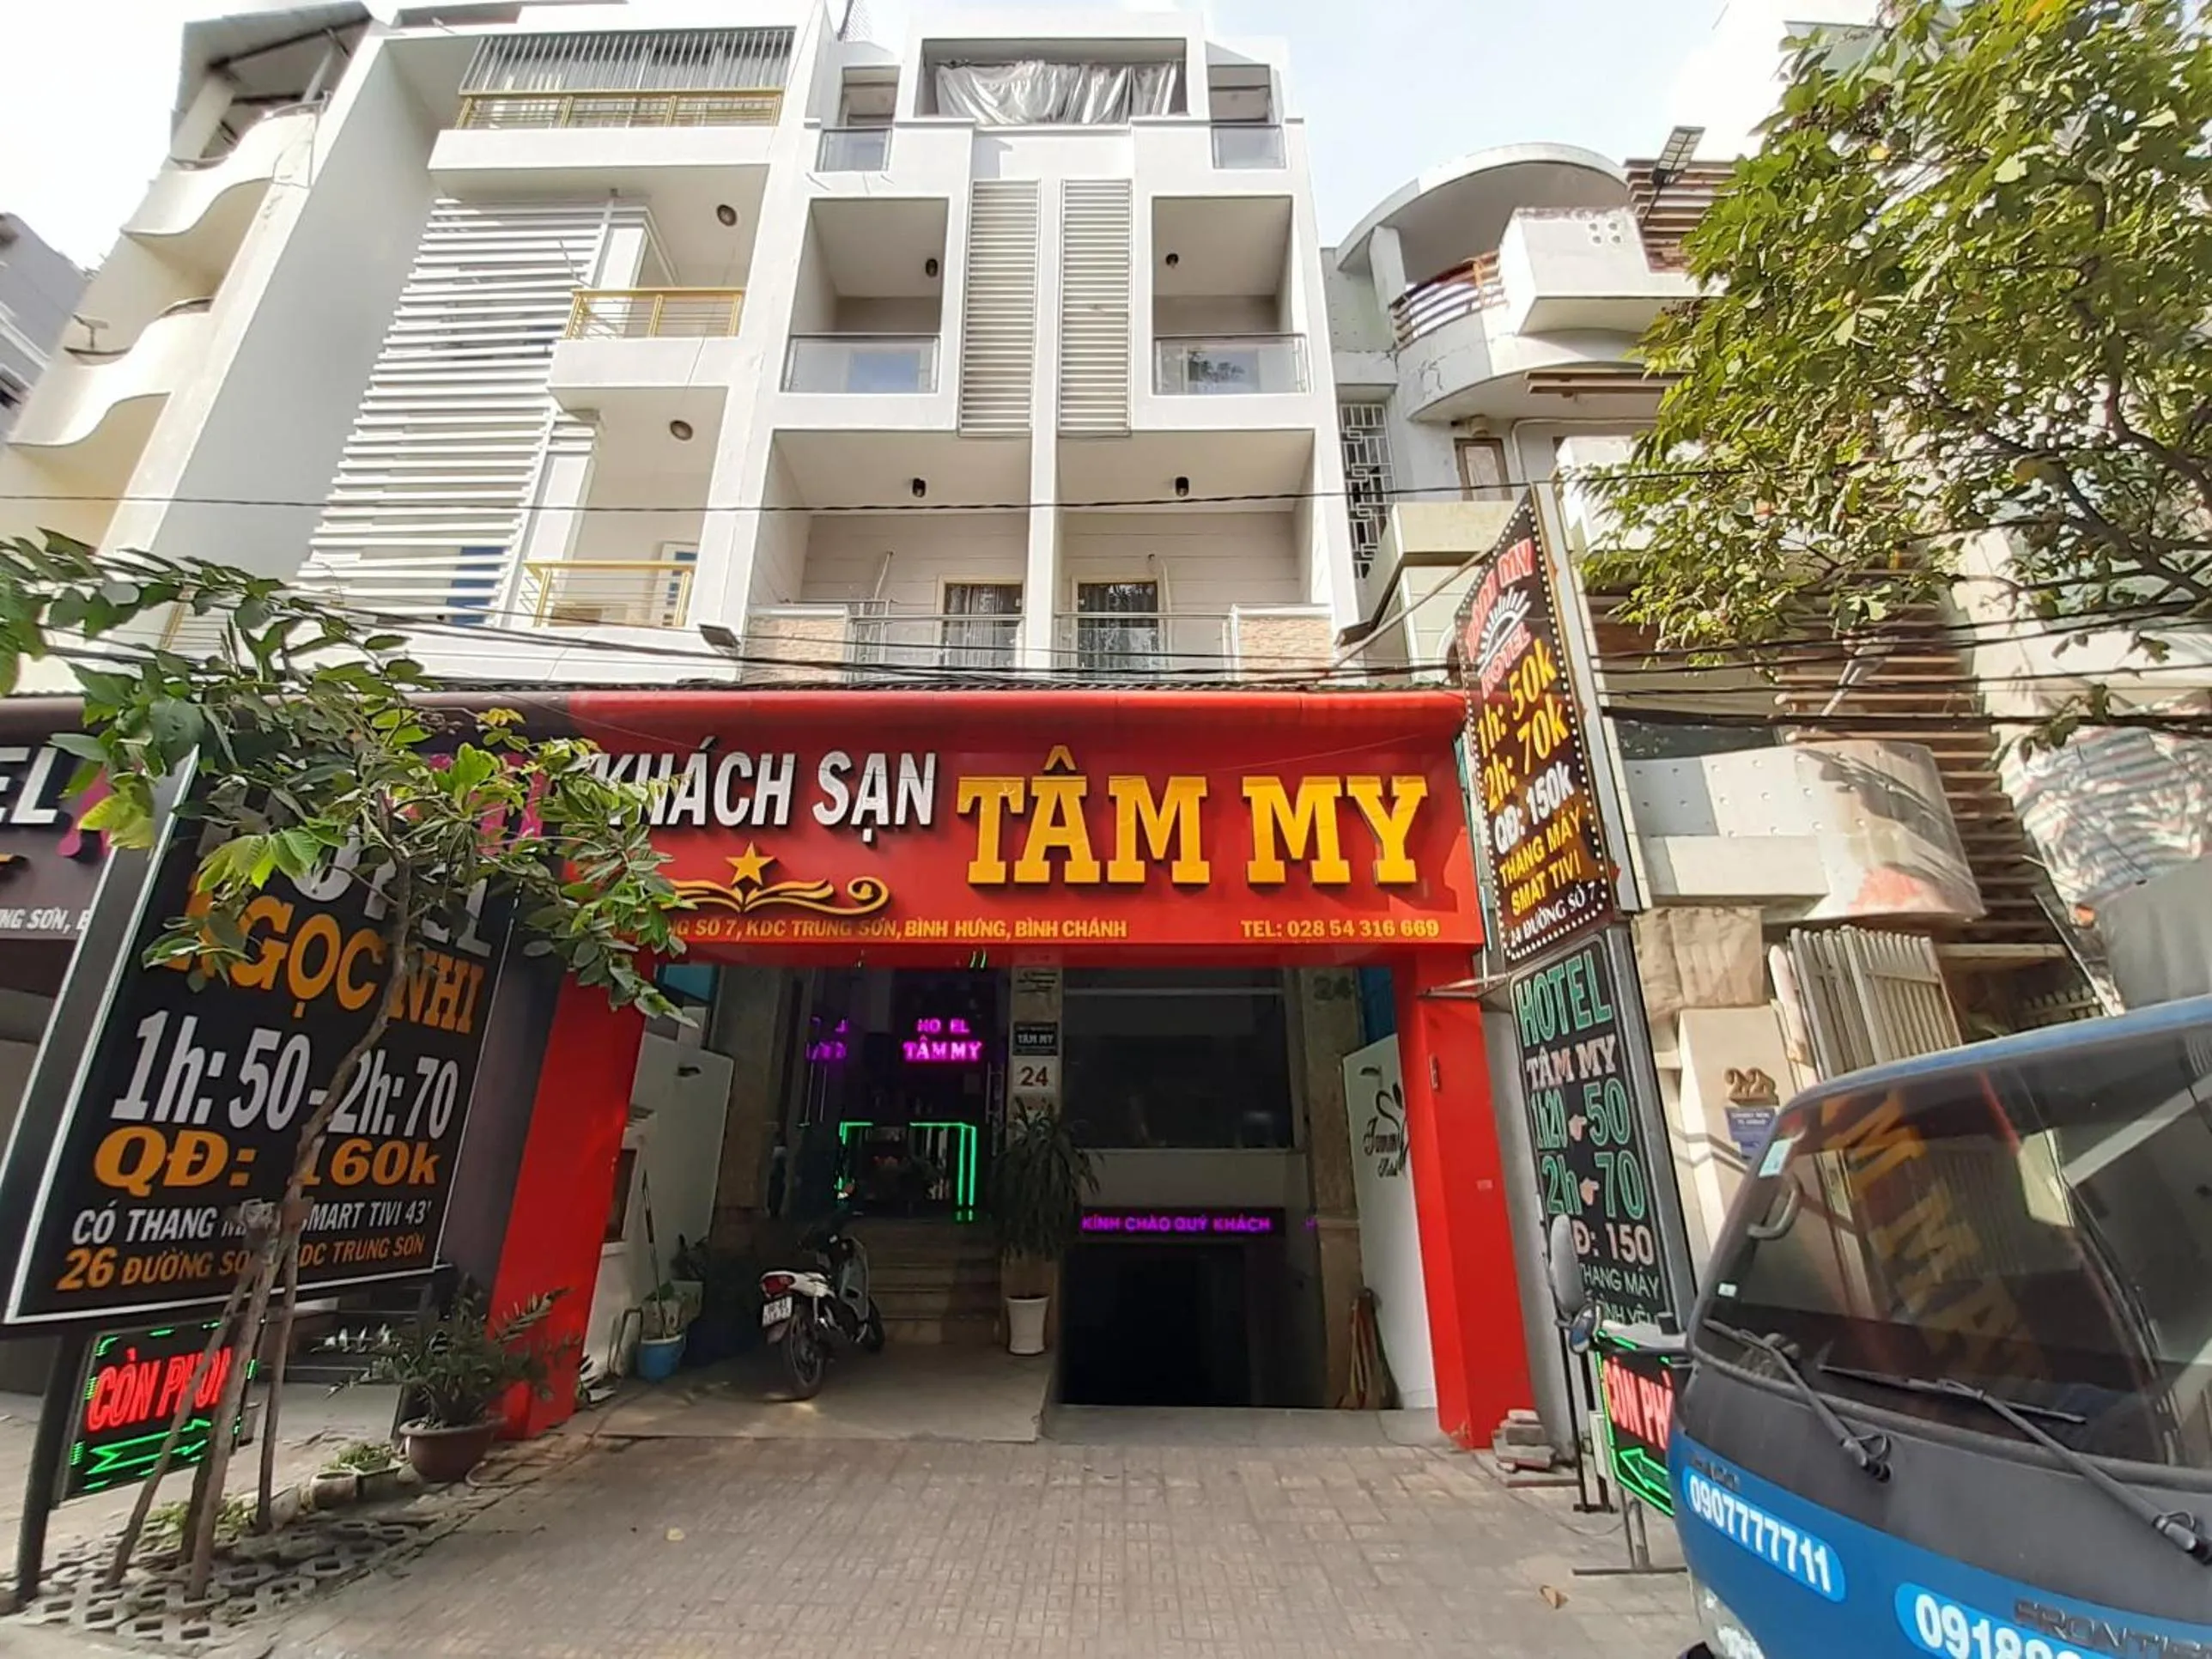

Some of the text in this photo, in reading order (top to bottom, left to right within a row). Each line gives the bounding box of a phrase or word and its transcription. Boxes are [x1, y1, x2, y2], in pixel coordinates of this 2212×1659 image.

[1481, 621, 1532, 700] HOTEL
[1479, 638, 1558, 758] 1h: 50k
[1484, 692, 1570, 812] 2h: 70k
[591, 736, 796, 827] KHÁCH
[811, 750, 936, 843] SẠN
[956, 744, 1211, 884] TÂM
[1242, 775, 1429, 884] MY
[1526, 760, 1575, 825] 150k
[1499, 805, 1582, 889] THANG MÁY
[1510, 848, 1582, 917] SMAT TIVI
[1587, 880, 1595, 902] 7
[745, 920, 786, 938] KDC
[792, 920, 853, 938] TRUNG
[904, 916, 948, 938] BÌNH
[1015, 917, 1058, 938] BÌNH
[1061, 917, 1127, 938] CHÁNH
[1241, 920, 1440, 938] TEL: 028 54 316 669
[385, 948, 486, 1034] NHI
[1515, 949, 1613, 1048] HOTEL
[111, 1011, 227, 1125] 1h:
[228, 1028, 312, 1131] 50
[327, 1048, 404, 1135] 2h:
[403, 1055, 459, 1139] 70
[1019, 1066, 1049, 1087] 24
[1525, 1033, 1617, 1091] TÂM MY
[1724, 1067, 1779, 1108] 22
[1583, 1077, 1632, 1146] 50
[93, 1126, 258, 1197] QĐ:
[1541, 1149, 1646, 1220] 2h 70
[71, 1199, 117, 1246] CÓ
[124, 1206, 218, 1243] THANG
[368, 1200, 403, 1227] TIVI
[1571, 1219, 1655, 1266] Đ: 150
[57, 1246, 119, 1291] 26
[297, 1242, 327, 1267] DC
[331, 1237, 391, 1264] TRUNG
[1623, 1266, 1660, 1301] MÁY
[88, 1346, 161, 1432] CÒN
[1690, 1474, 1832, 1595] 0907777711
[1915, 1593, 2082, 1659] 0918
